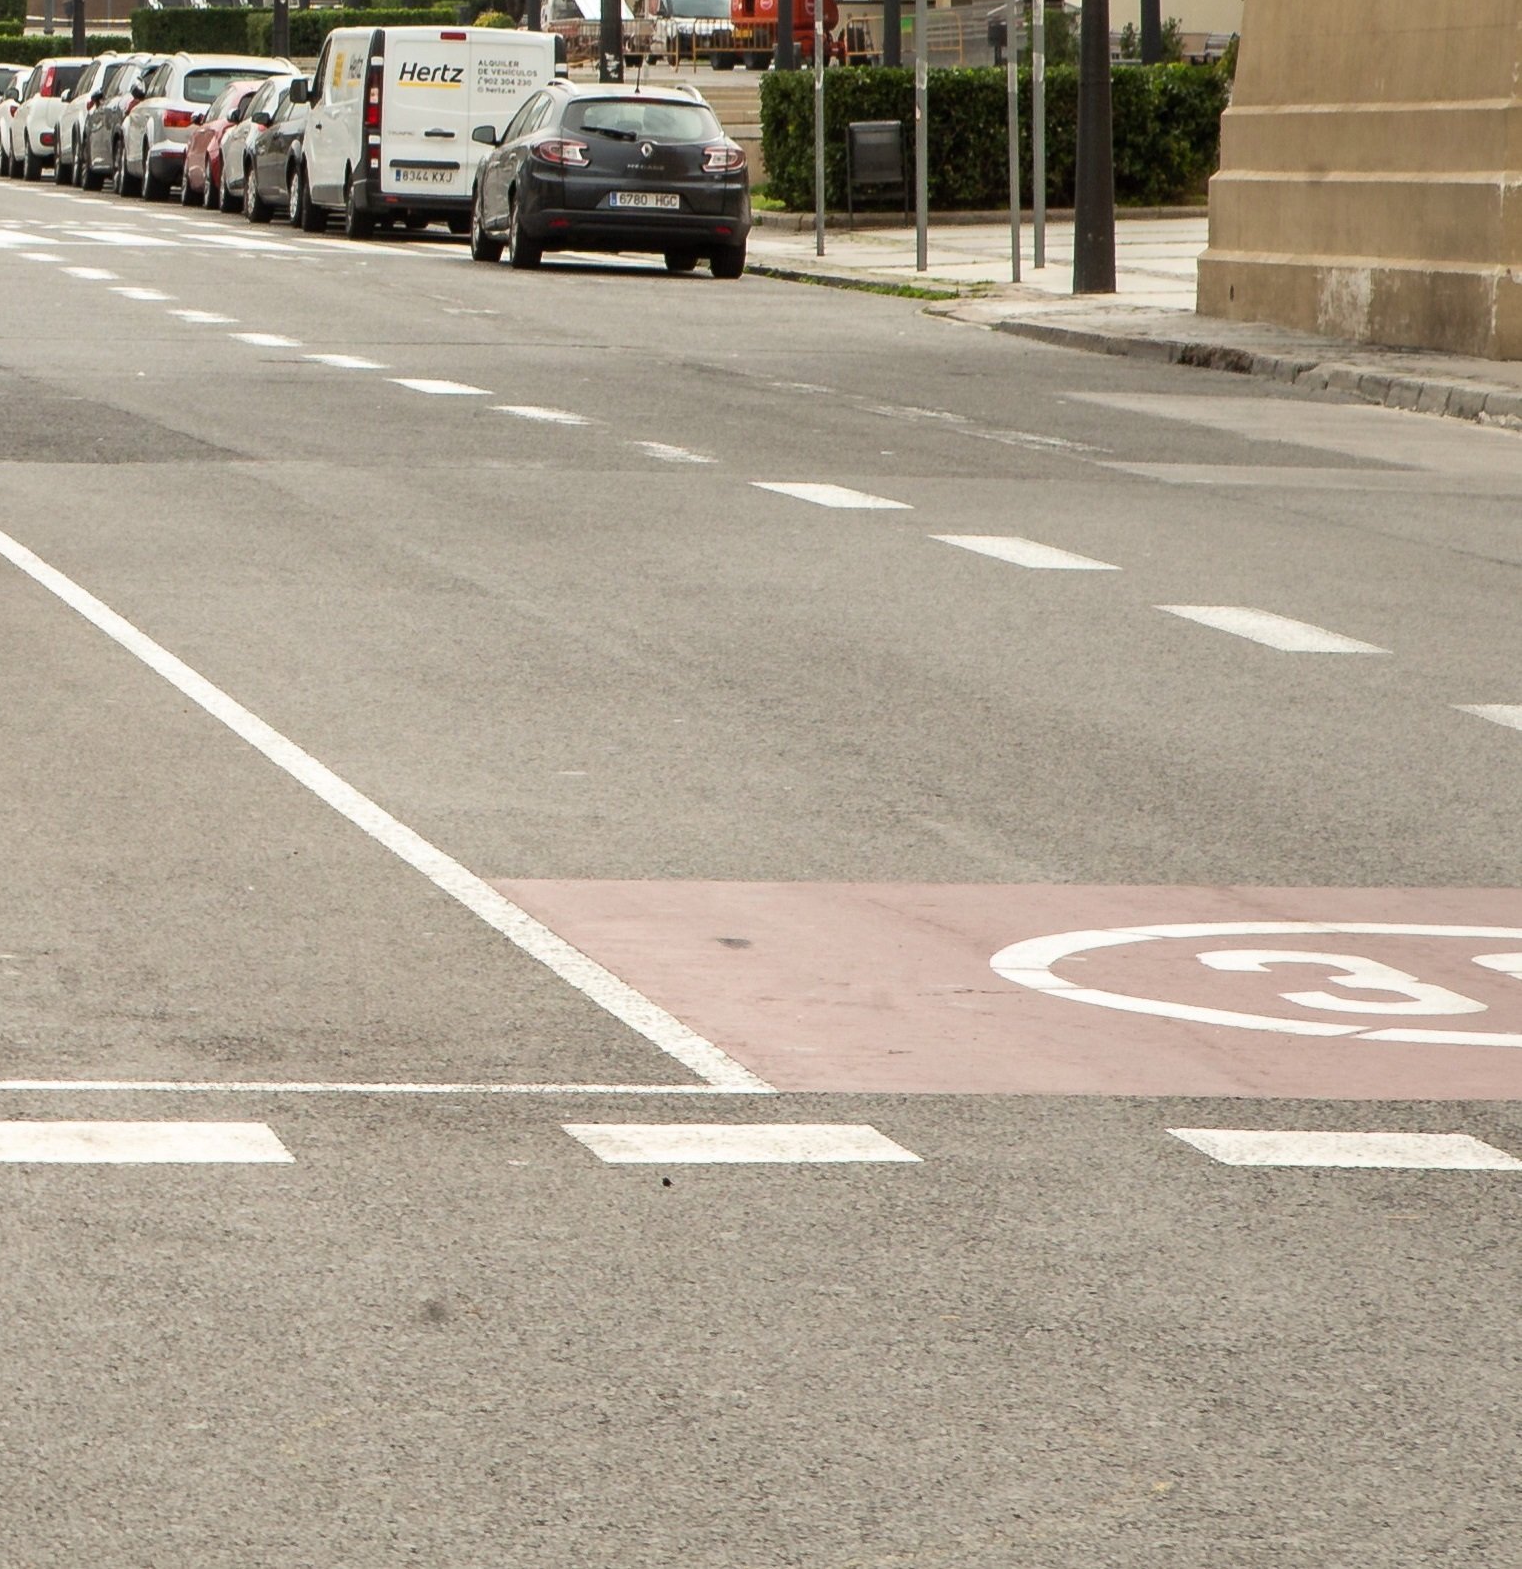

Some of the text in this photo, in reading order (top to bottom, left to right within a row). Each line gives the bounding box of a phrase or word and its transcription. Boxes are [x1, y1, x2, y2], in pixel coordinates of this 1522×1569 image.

[478, 60, 519, 68] ALQUILER
[398, 62, 464, 83] Hertz
[402, 170, 453, 183] 8344 KXJ
[619, 193, 677, 206] 6780 HGC
[1196, 948, 1522, 1016] 3
